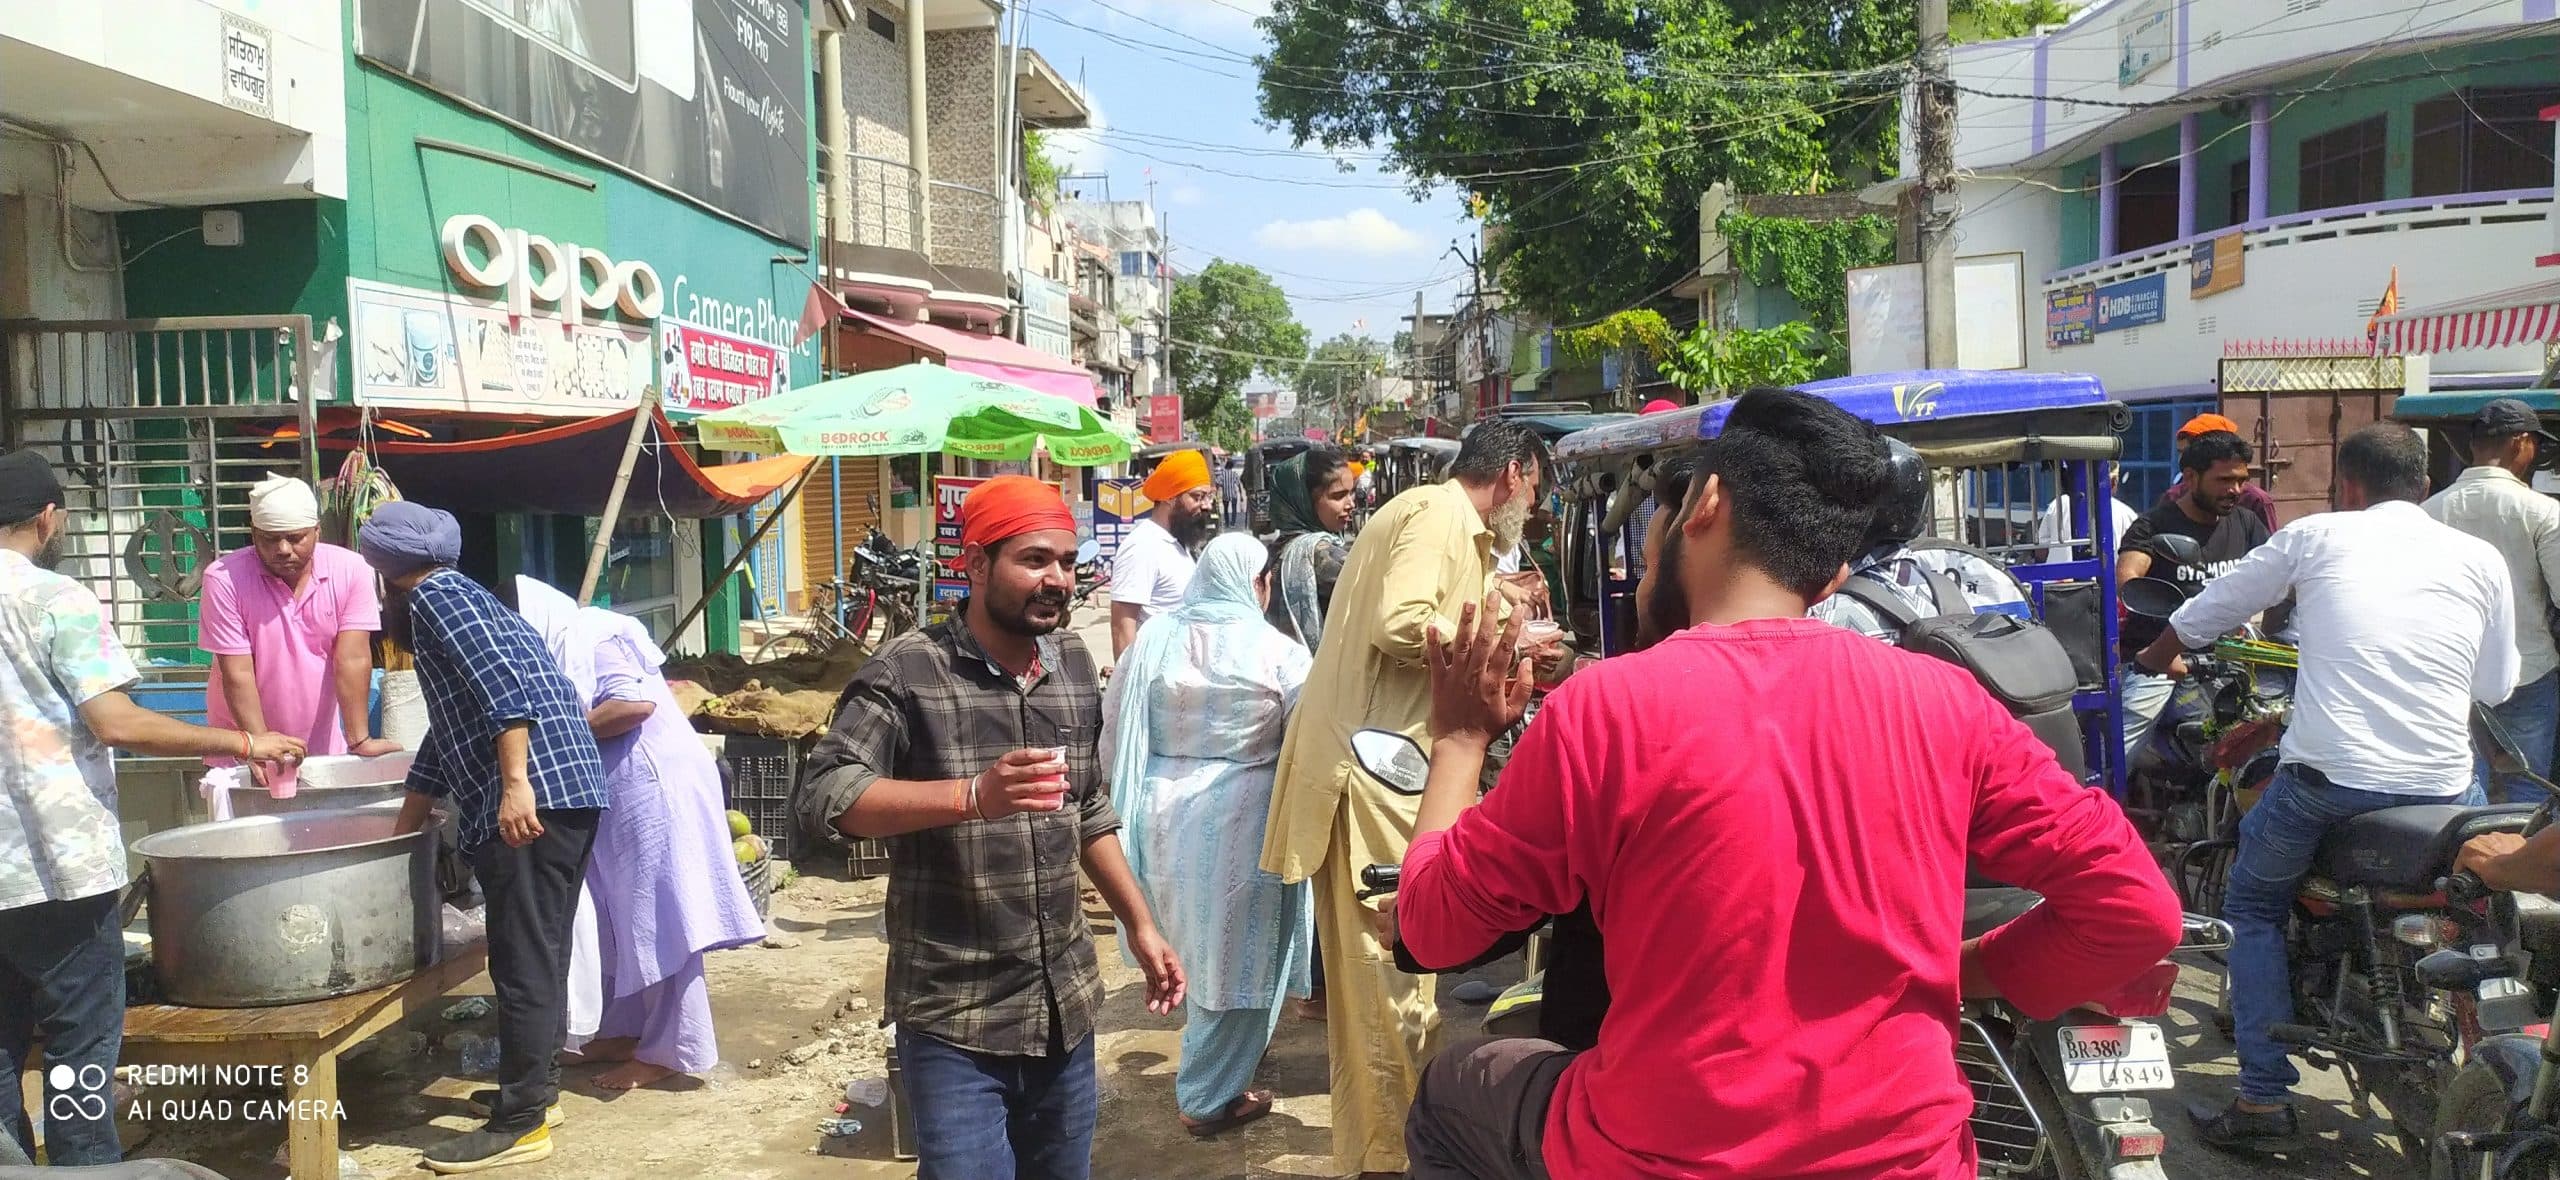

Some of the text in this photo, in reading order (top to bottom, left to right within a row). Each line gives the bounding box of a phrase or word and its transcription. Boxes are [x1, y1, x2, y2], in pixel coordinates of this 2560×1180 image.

[736, 14, 769, 63] F19 Pro
[674, 275, 753, 337] Camera
[2109, 295, 2132, 318] HDB
[820, 431, 889, 445] BEDROCK
[2108, 1065, 2164, 1086] 4849
